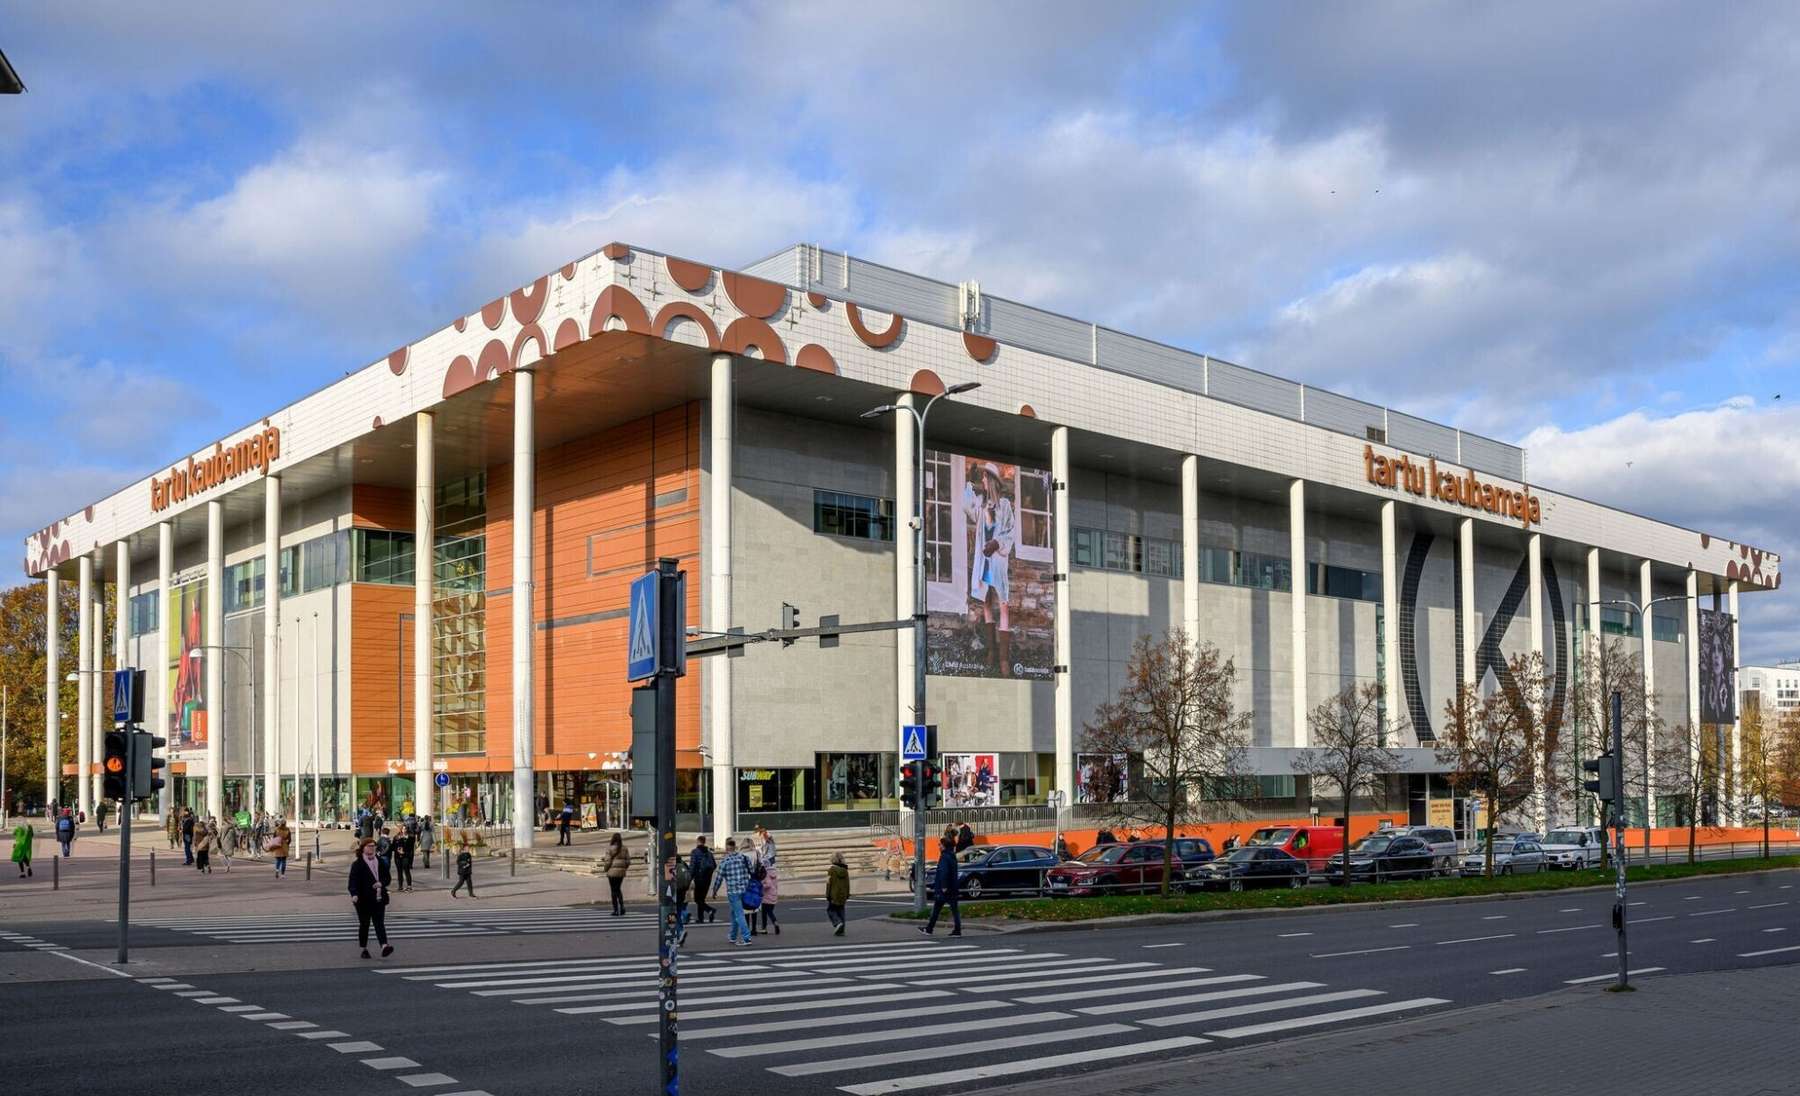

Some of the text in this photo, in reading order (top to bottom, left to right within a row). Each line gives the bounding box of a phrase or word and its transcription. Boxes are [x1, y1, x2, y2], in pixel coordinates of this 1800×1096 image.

[151, 416, 280, 512] tartu kaubamaja
[1364, 445, 1541, 529] tartu kaubamaja
[740, 770, 776, 780] SUBWAY
